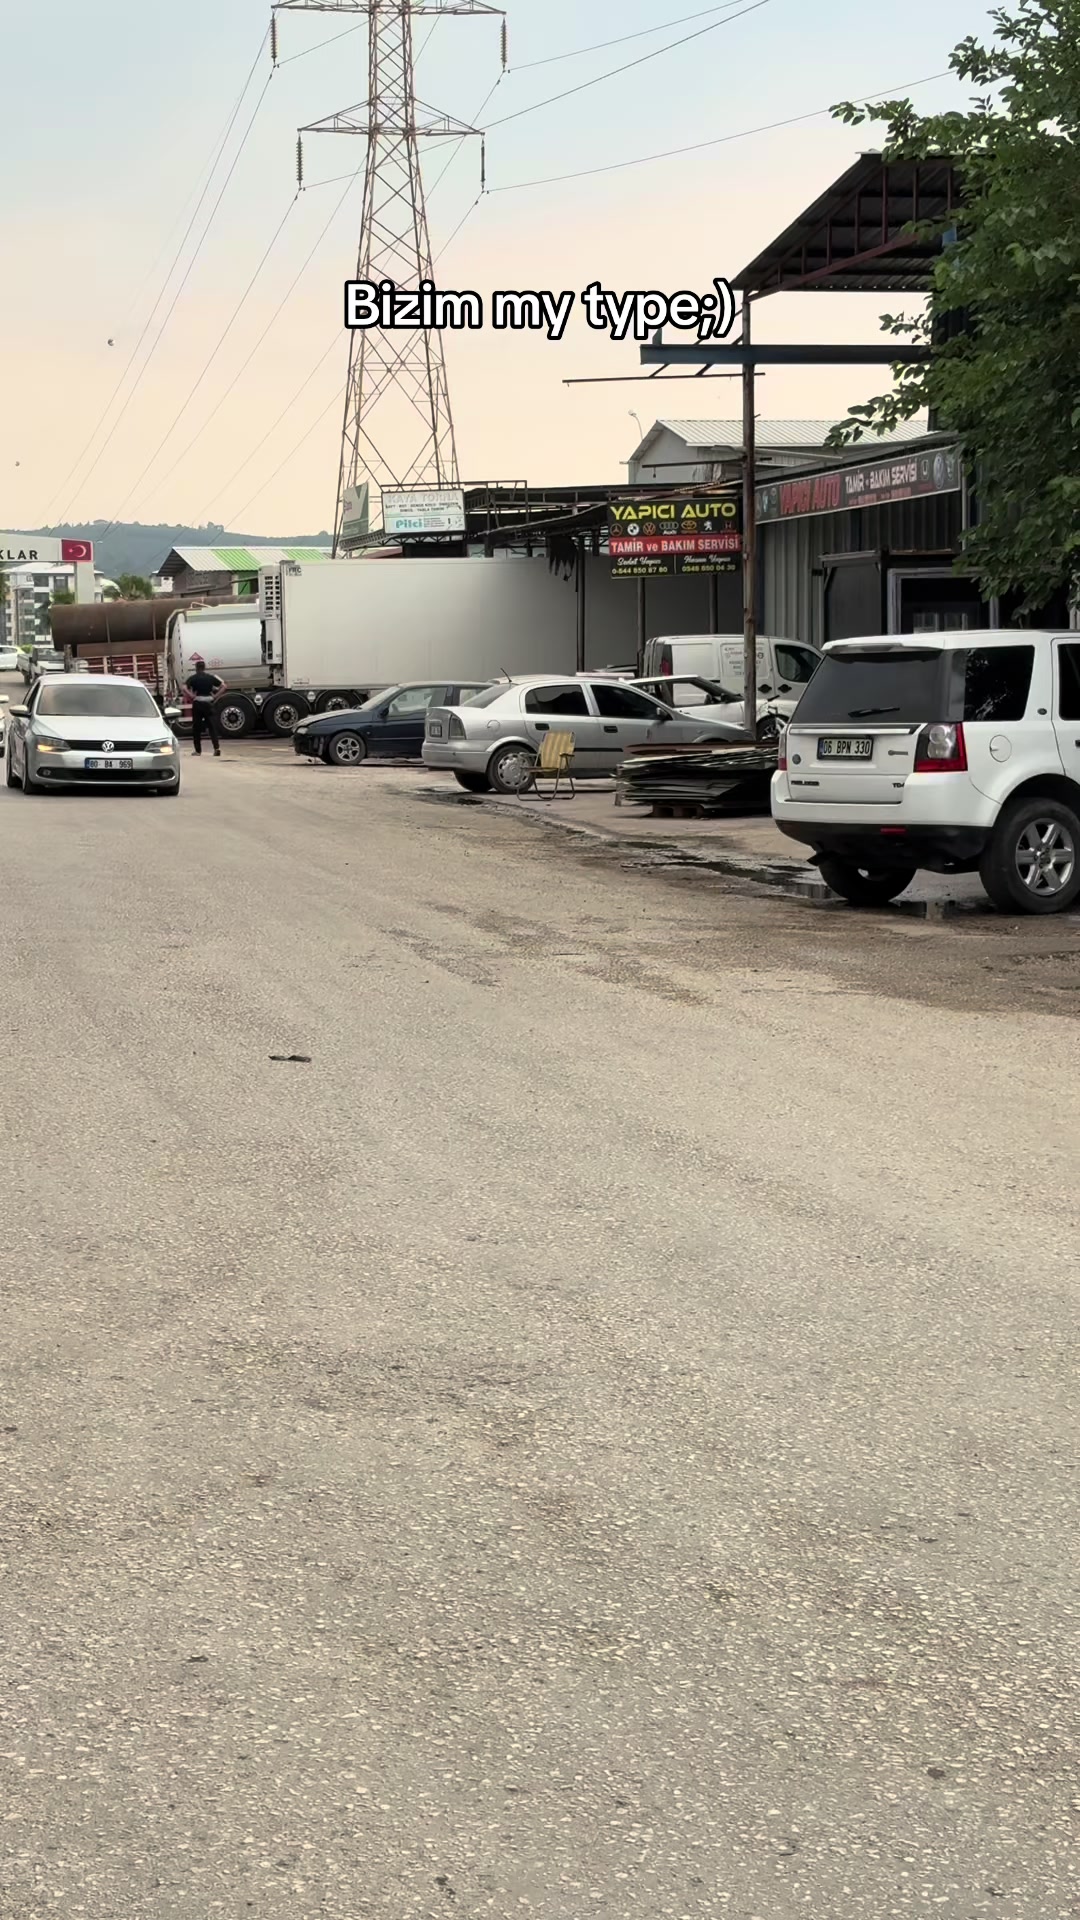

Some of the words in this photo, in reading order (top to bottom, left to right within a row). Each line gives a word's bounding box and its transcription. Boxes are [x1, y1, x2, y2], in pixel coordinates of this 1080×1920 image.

[813, 474, 841, 508] AUTO
[610, 504, 675, 520] YAPICI
[681, 503, 736, 518] AUTO
[611, 538, 643, 553] TAMİR
[646, 543, 658, 552] ve
[661, 539, 695, 552] BAKIM
[697, 534, 738, 550] SERVİSİ
[823, 741, 832, 754] 06
[836, 741, 851, 754] BPN
[854, 741, 871, 754] 330
